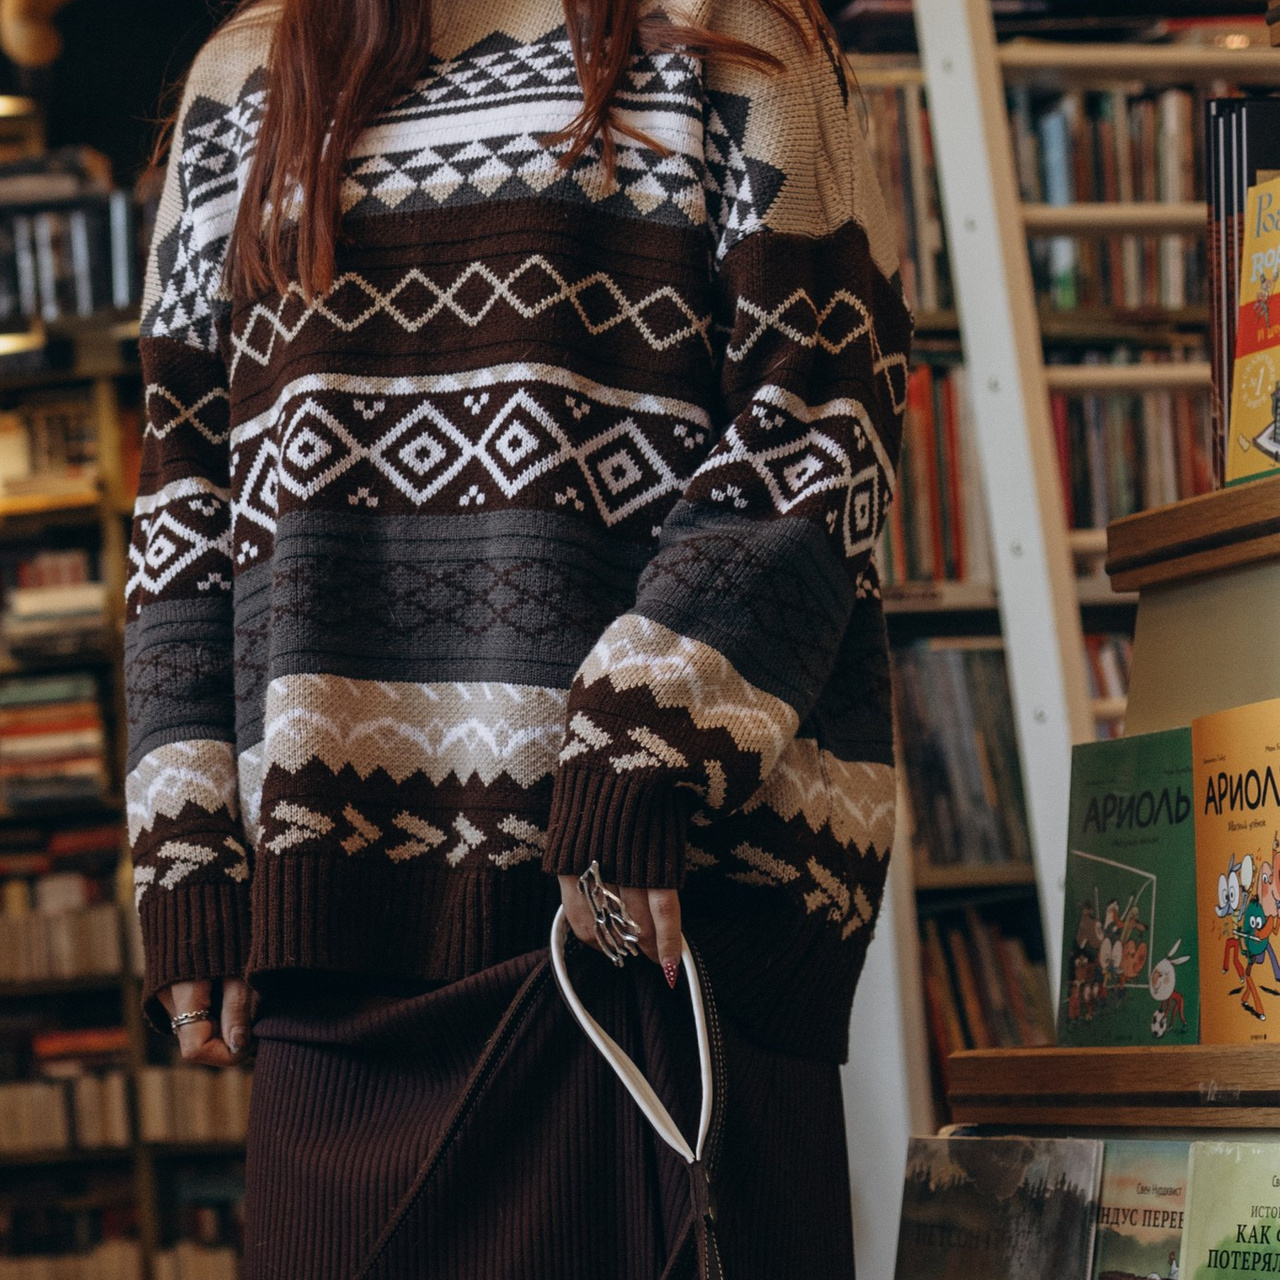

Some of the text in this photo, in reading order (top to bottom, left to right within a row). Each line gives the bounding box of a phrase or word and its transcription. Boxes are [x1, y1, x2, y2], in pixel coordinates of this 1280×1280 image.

[1083, 784, 1191, 834] АРИОЛЬ
[1204, 765, 1280, 815] АРИОЛ
[1235, 1224, 1271, 1245] КАК
